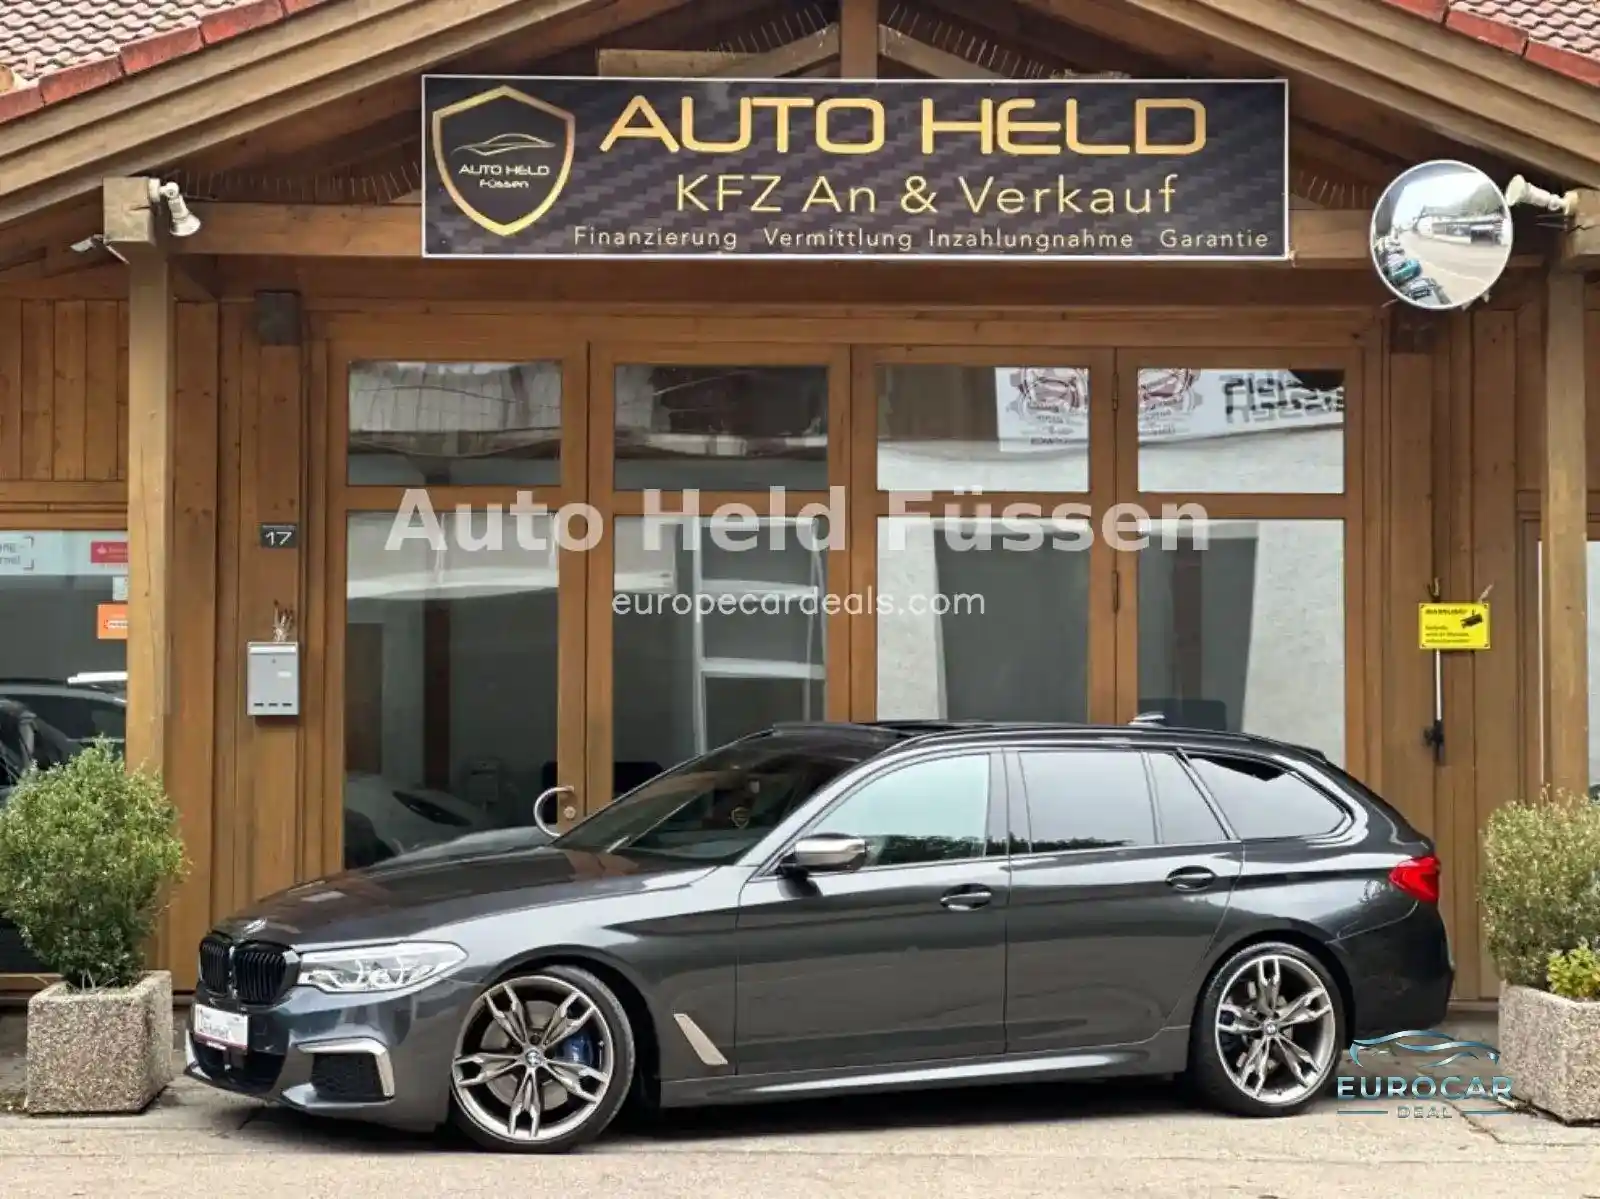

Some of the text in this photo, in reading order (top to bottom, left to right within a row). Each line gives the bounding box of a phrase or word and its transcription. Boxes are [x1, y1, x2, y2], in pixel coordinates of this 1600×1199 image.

[599, 95, 1207, 155] AUTO HELD
[458, 164, 550, 176] AUTO HELD
[677, 173, 1179, 214] KFZ An & Verkauf
[573, 225, 1269, 252] Finanzierung Vermittlung Inzahlungnahme Garantie
[265, 531, 292, 546] 17
